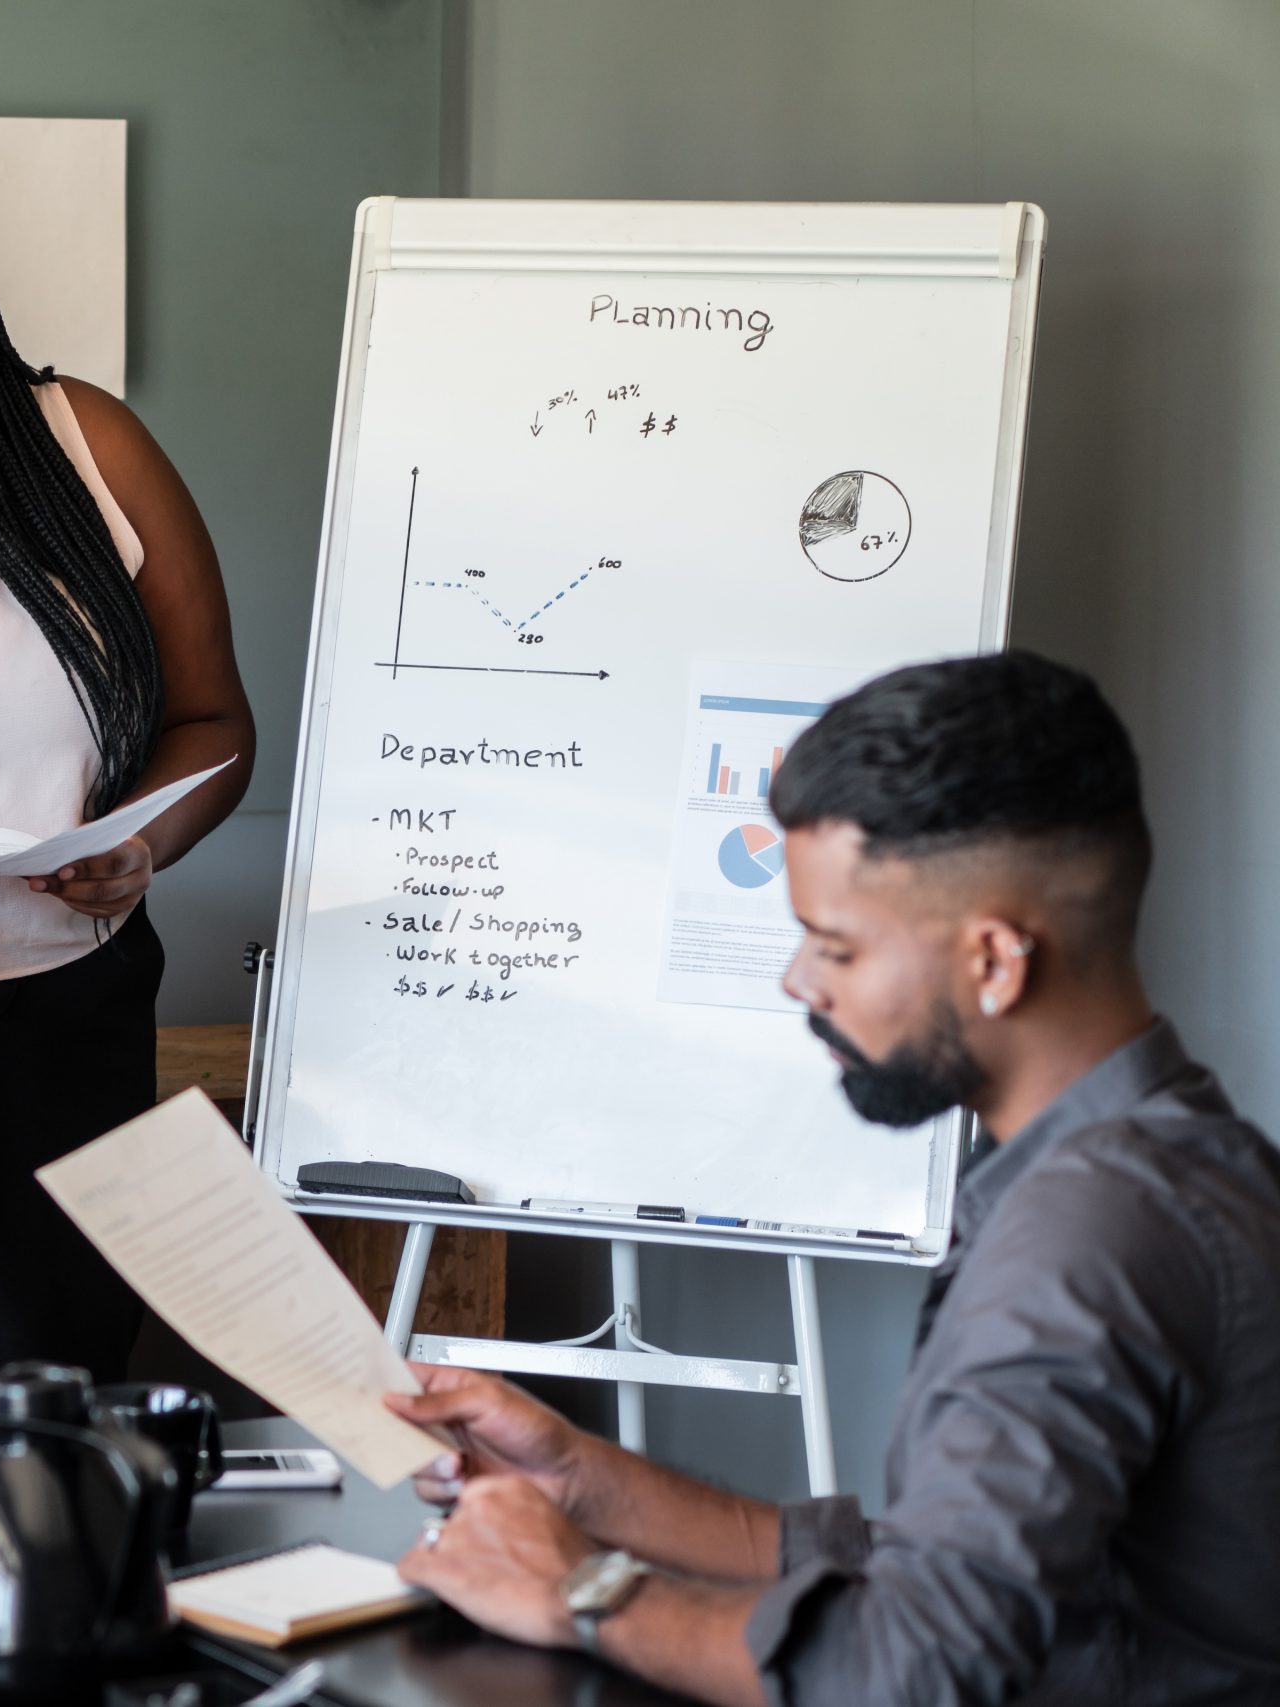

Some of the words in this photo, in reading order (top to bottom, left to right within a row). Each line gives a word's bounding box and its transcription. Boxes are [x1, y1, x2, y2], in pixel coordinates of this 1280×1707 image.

[548, 389, 578, 411] 30%
[607, 384, 641, 401] 47%
[860, 531, 899, 551] 67%
[464, 568, 486, 578] 400
[598, 556, 623, 569] 600
[380, 733, 583, 769] Department
[389, 808, 457, 833] MKT
[406, 846, 500, 873] Prospect
[469, 913, 583, 943] Shopping
[396, 944, 457, 965] Work
[468, 949, 580, 981] together
